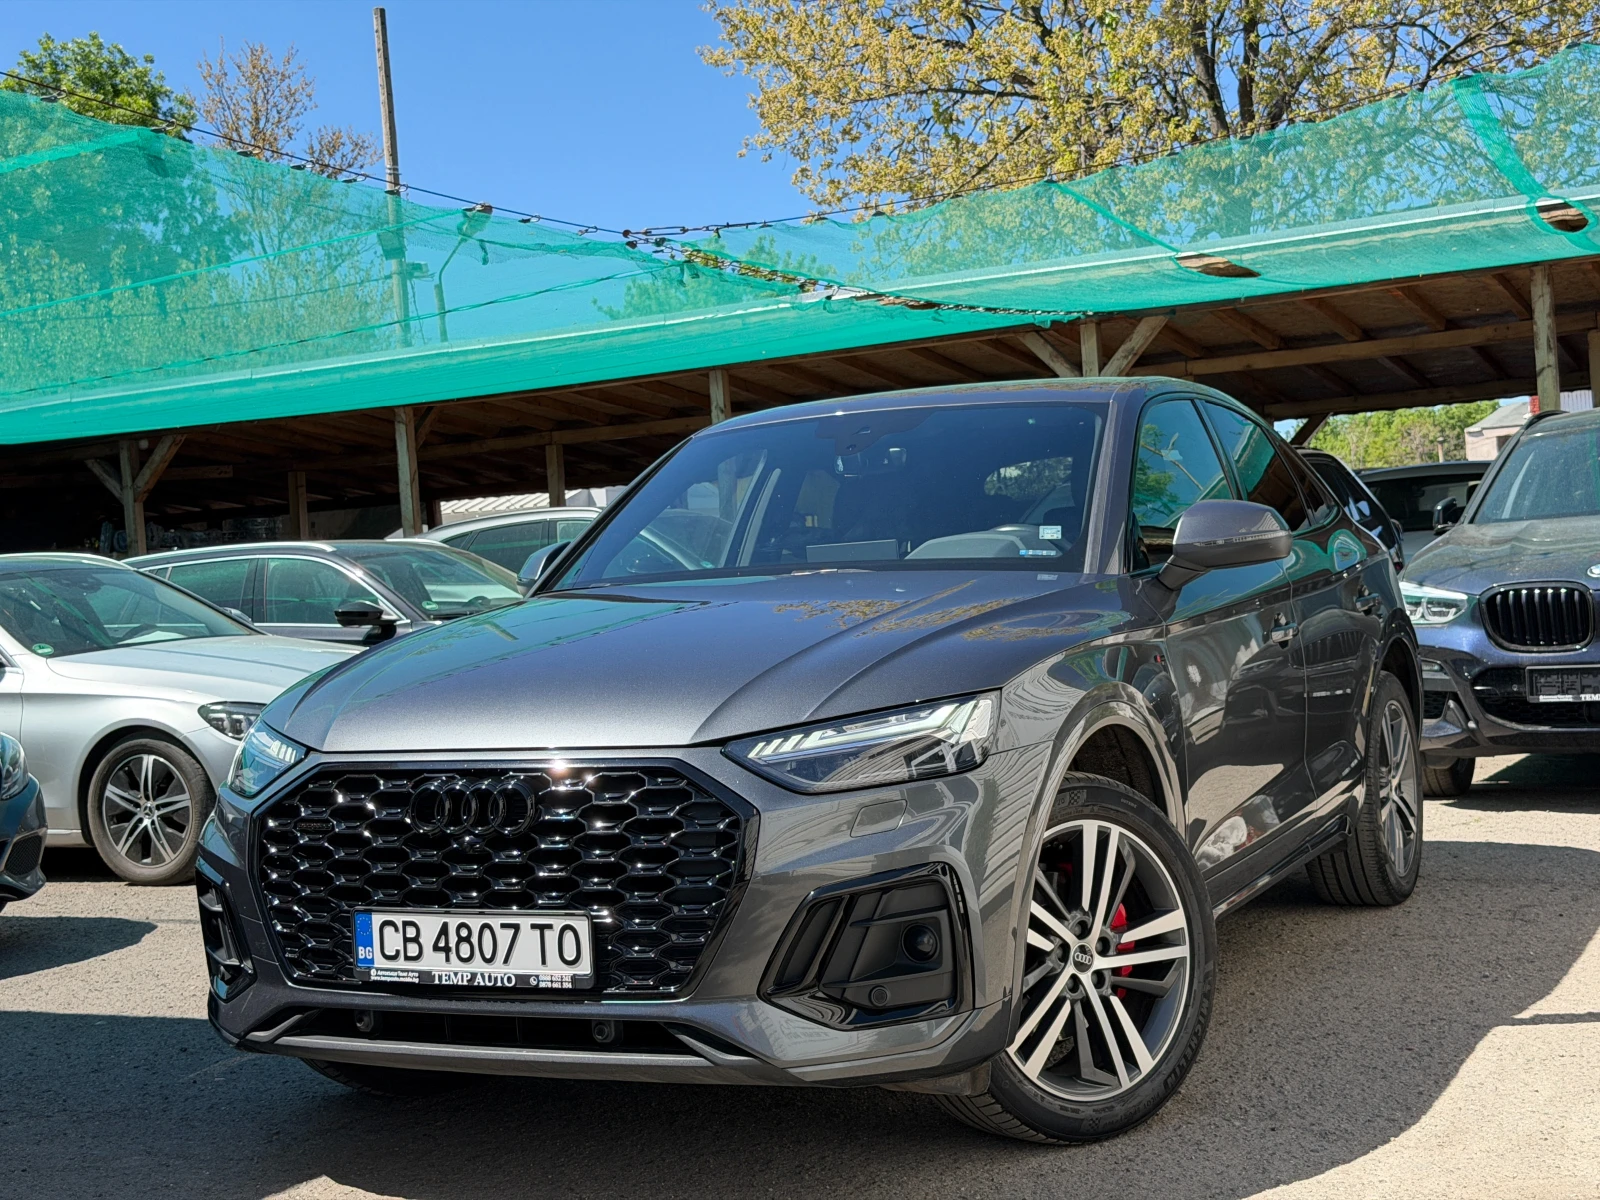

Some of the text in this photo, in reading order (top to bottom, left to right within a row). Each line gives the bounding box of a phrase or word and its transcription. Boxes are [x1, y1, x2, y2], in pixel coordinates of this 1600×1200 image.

[379, 919, 581, 967] CB 4807 TO
[358, 946, 373, 960] BG
[432, 971, 516, 987] TEMP AUTO
